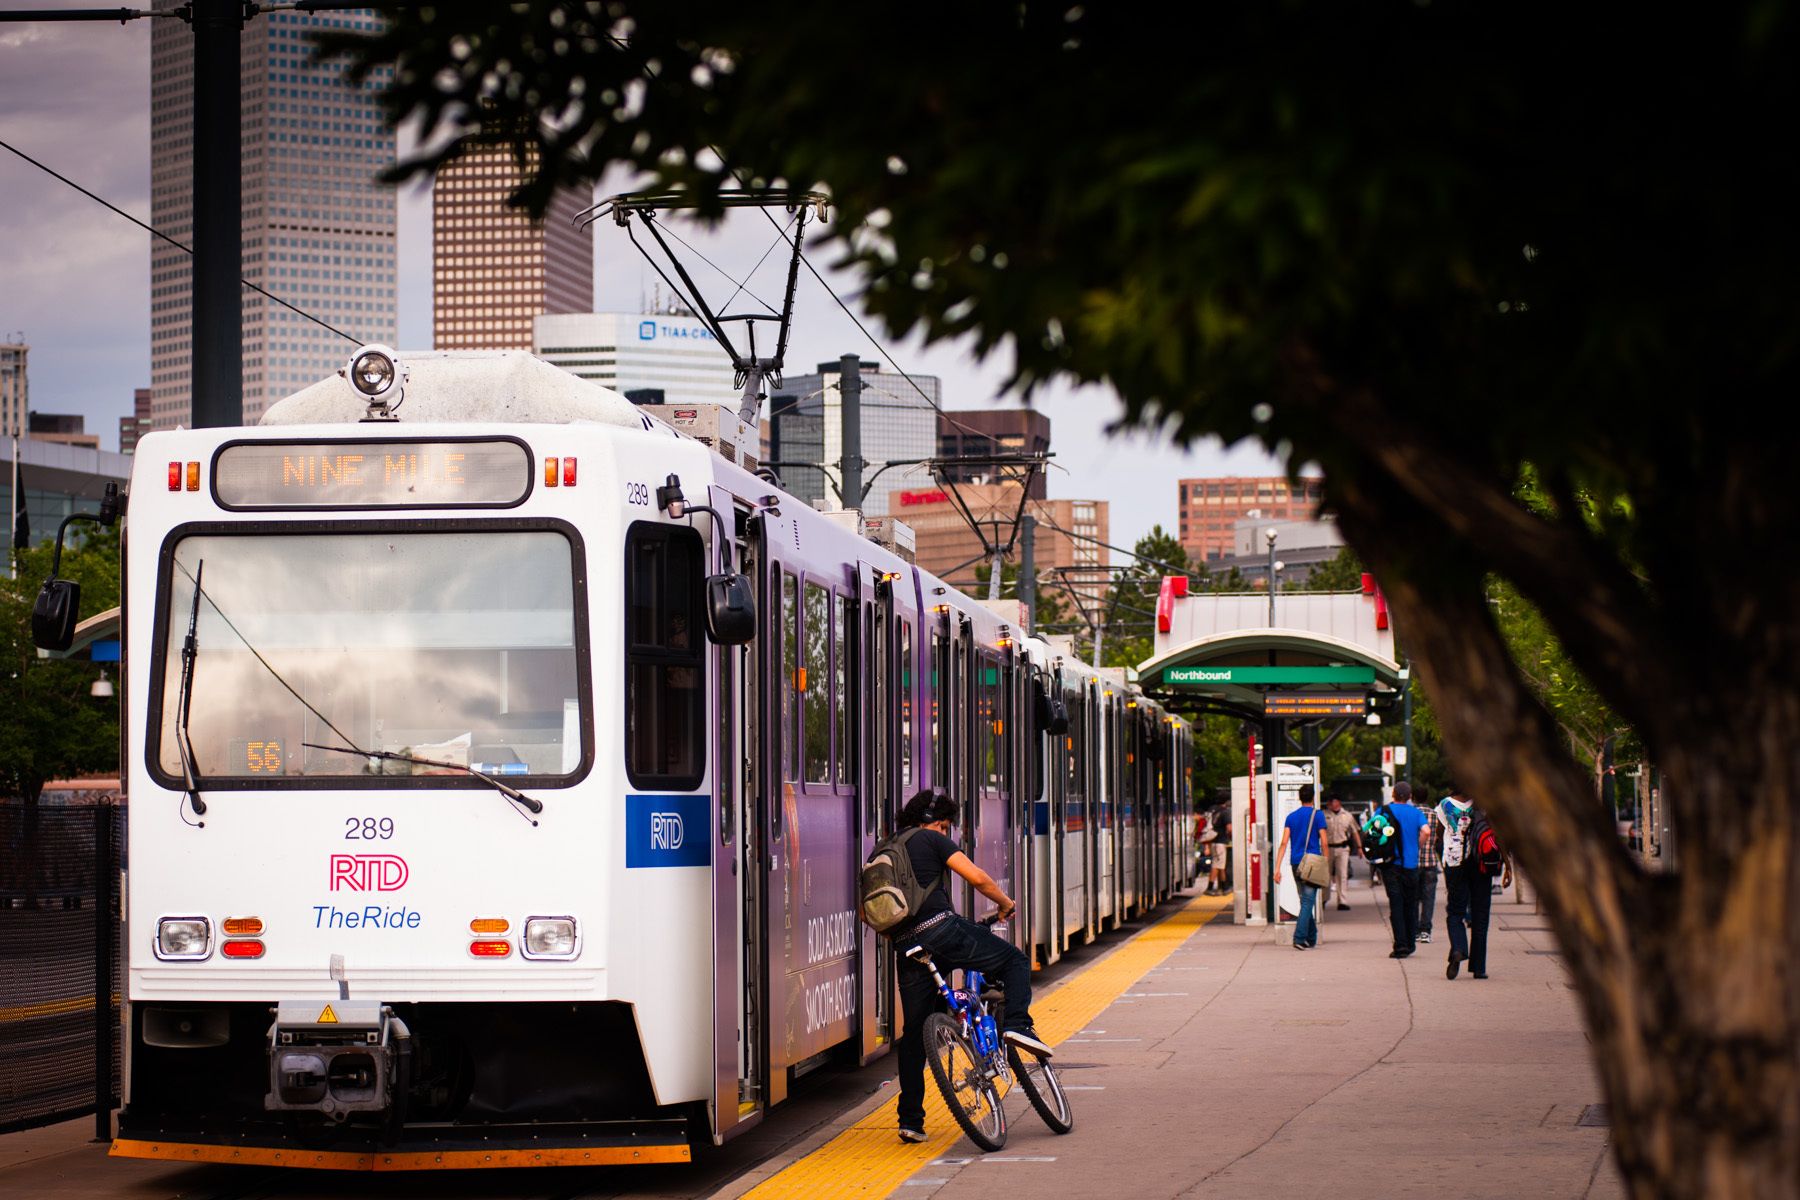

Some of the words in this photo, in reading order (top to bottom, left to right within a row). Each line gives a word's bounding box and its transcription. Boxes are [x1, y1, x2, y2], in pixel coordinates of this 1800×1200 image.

[662, 327, 717, 340] TIAA-CRE
[283, 455, 363, 486] NINE
[386, 453, 465, 484] MILE
[627, 482, 649, 506] 289
[1170, 671, 1231, 680] Northbound
[248, 741, 280, 772] 56
[345, 817, 394, 840] 289
[651, 812, 684, 850] RTD
[330, 854, 409, 891] RTD
[313, 906, 421, 928] TheRide
[808, 916, 824, 964] BOLD
[825, 913, 834, 958] AS
[806, 980, 834, 1034] SMOOTH
[835, 976, 843, 1020] AS
